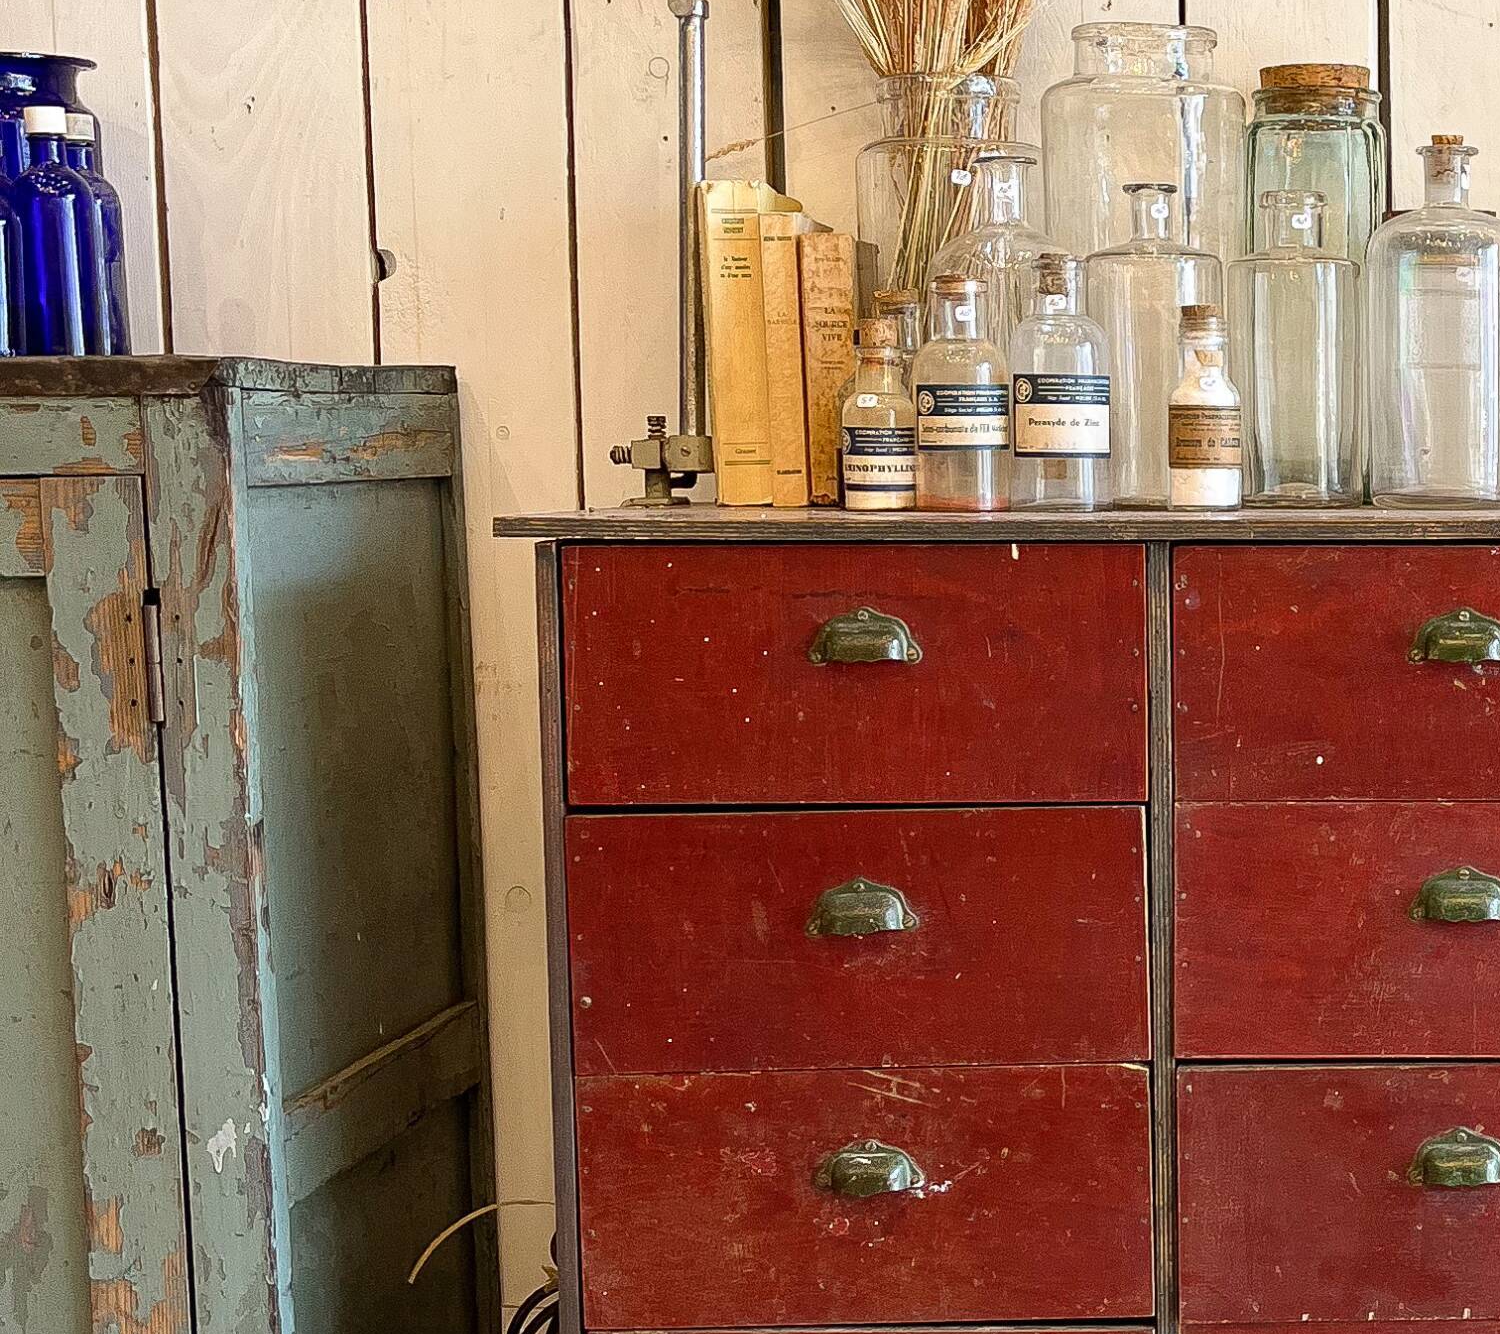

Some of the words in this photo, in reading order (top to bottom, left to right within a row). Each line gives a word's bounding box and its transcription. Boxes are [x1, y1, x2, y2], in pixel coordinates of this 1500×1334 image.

[815, 320, 848, 329] SOURCE
[821, 333, 842, 342] VIVE
[1028, 417, 1067, 427] Peroxyde
[1069, 418, 1081, 427] de
